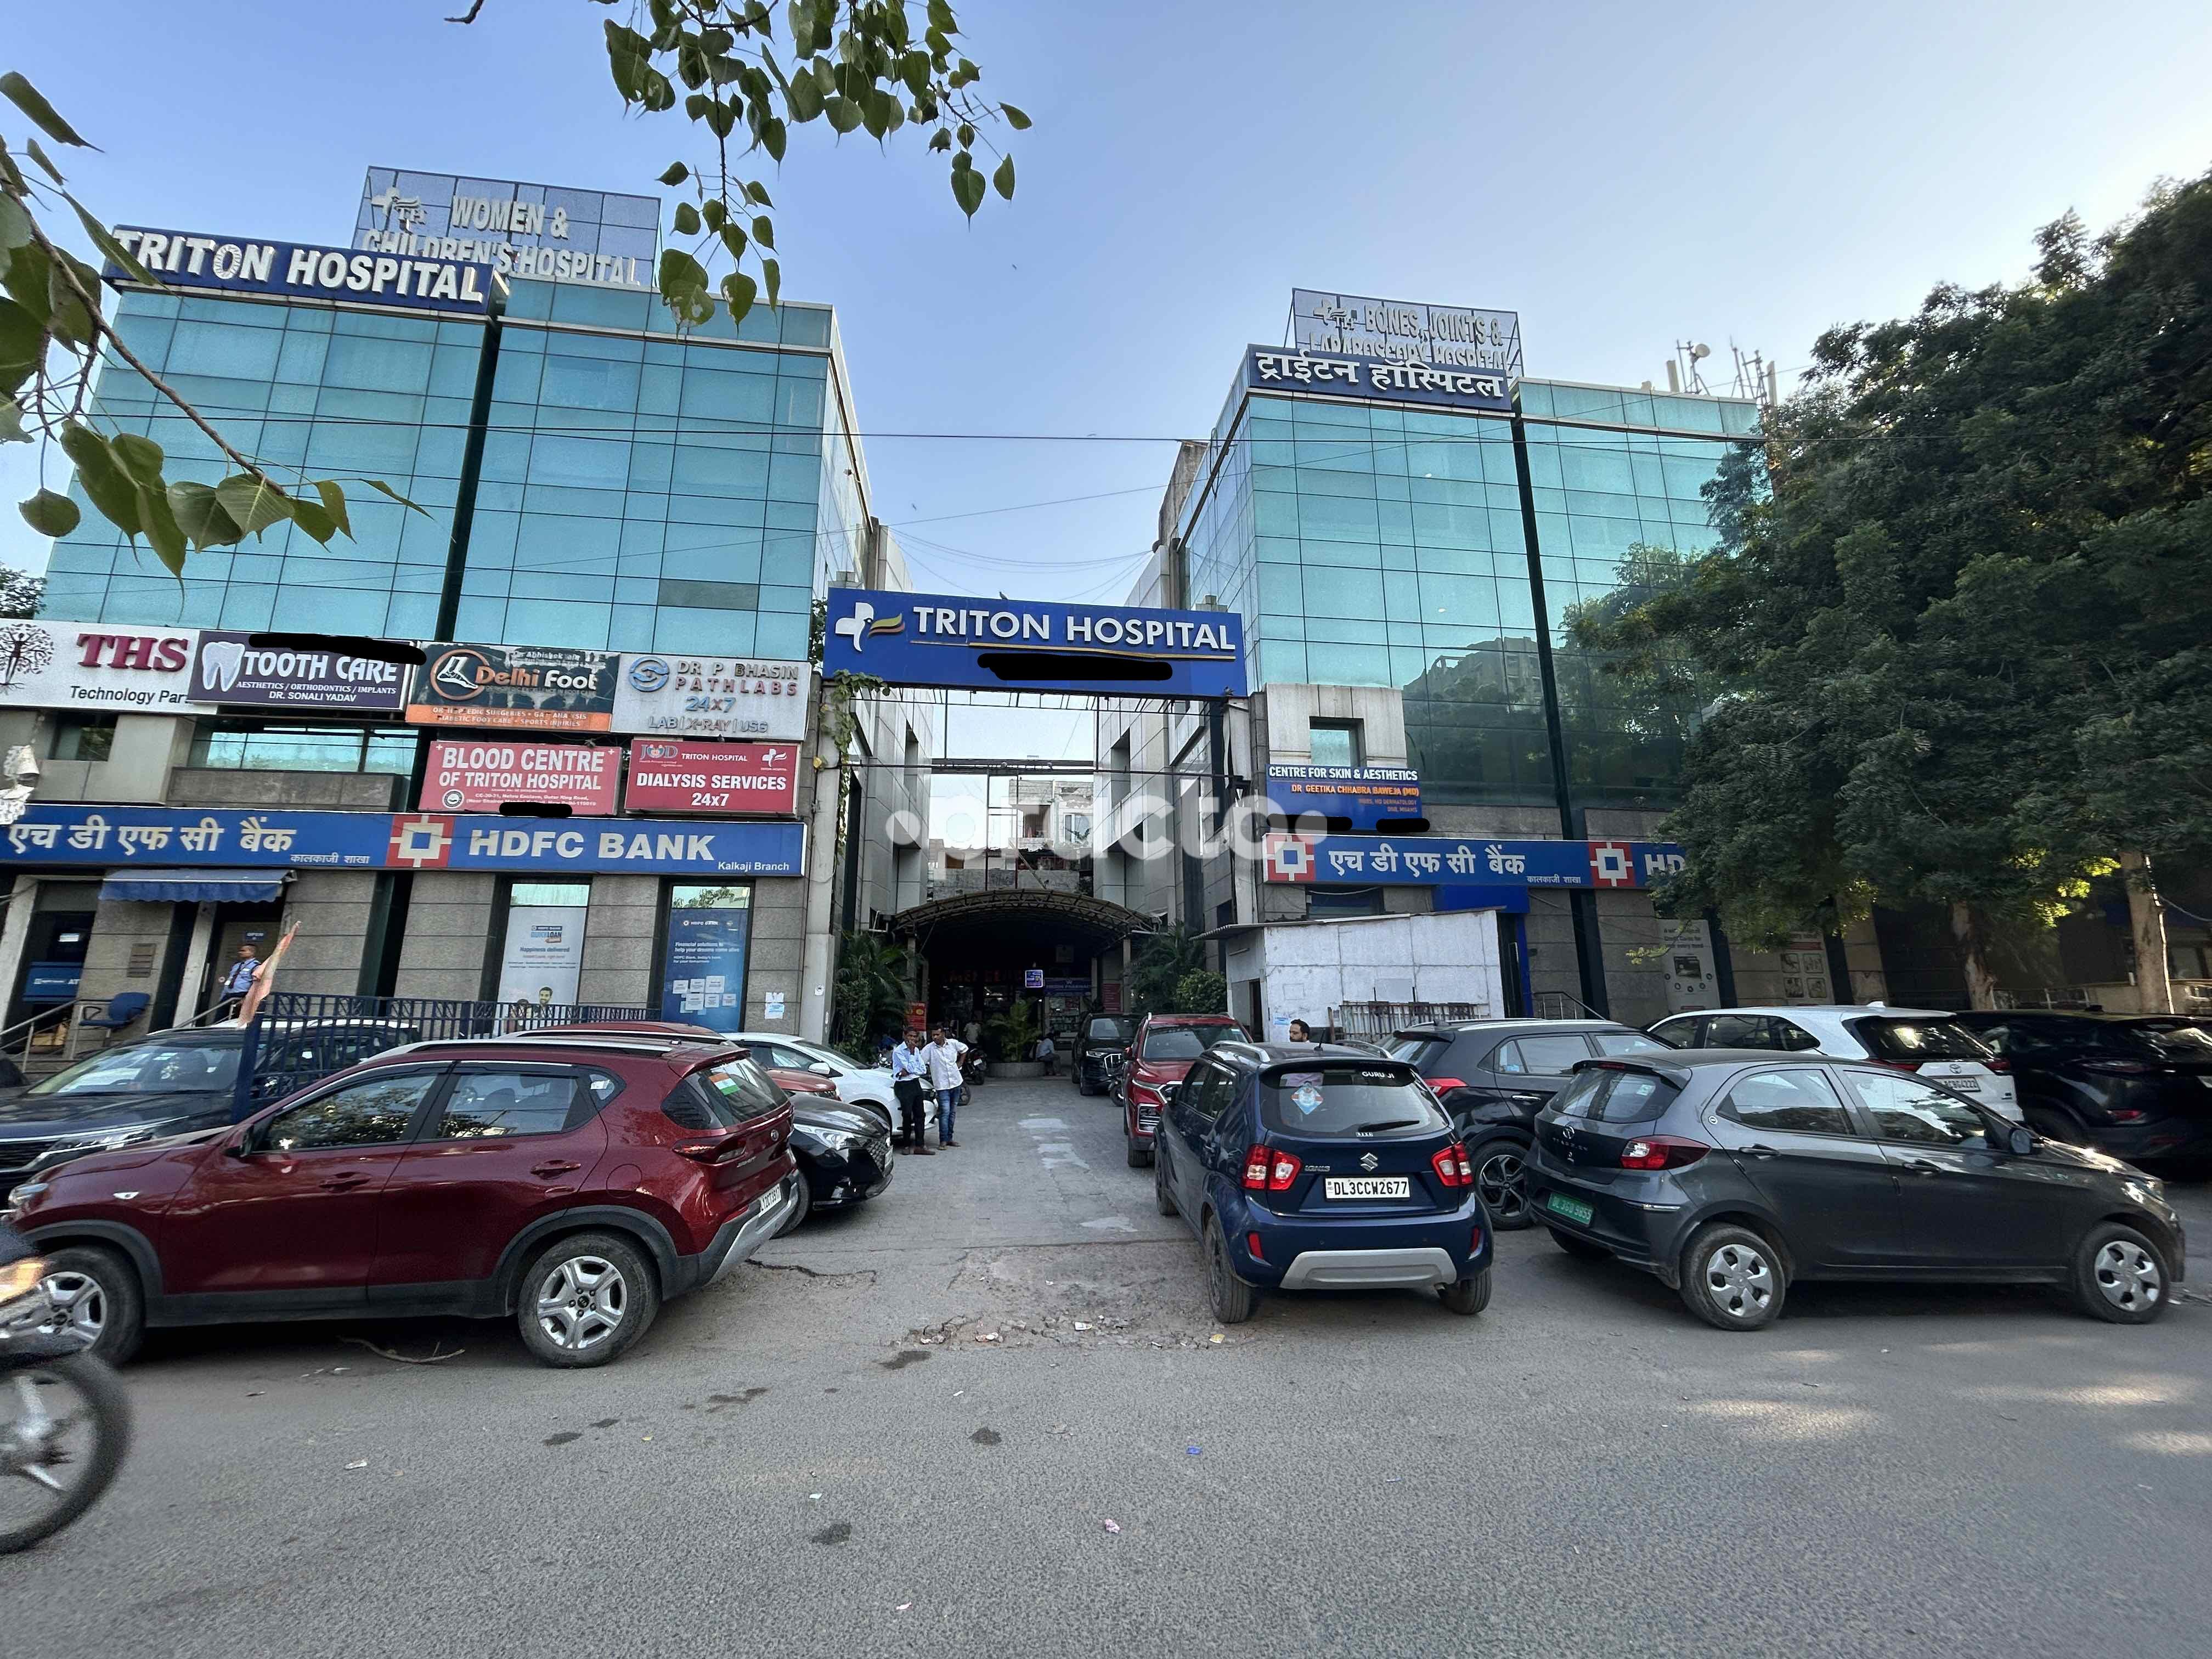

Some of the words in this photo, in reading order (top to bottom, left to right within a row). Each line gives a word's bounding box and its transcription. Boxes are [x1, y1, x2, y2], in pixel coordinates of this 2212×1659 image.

[452, 195, 544, 234] WOMEN
[550, 208, 568, 240] &
[111, 229, 275, 281] TRITON
[287, 249, 486, 303] HOSPITAL
[520, 250, 639, 284] HOSPITAL
[1429, 311, 1487, 345] JOINTS
[1491, 318, 1504, 346] &
[1256, 348, 1360, 383] ट्राईटन
[1369, 359, 1504, 398] हॉस्पिटल
[913, 606, 1050, 640] TRITON
[1067, 615, 1236, 651] HOSPITAL
[77, 633, 189, 672] THS
[244, 651, 329, 681] TOOTH
[336, 656, 398, 684] CARE
[677, 660, 702, 675] DR
[713, 663, 724, 676] P
[734, 663, 799, 680] BHASIN
[236, 681, 284, 690] AESTHETICS
[291, 683, 352, 693] ORTHODONTICS
[358, 686, 397, 695] IMPLANTS
[476, 666, 540, 687] Delhi
[544, 669, 597, 690] Foot
[675, 676, 799, 696] PATHLABS
[71, 686, 155, 704] Technology
[159, 690, 191, 704] Par
[269, 691, 285, 699] DR.
[288, 692, 323, 701] SONALI
[325, 693, 357, 703] YADAV
[442, 747, 515, 770] BLOOD
[521, 748, 605, 772] CENTRE
[681, 753, 709, 761] TRITON
[712, 754, 748, 762] HOSPITAL
[439, 771, 460, 787] OF
[465, 772, 522, 788] TRITON
[526, 774, 601, 790] HOSPITAL
[636, 772, 706, 789] DIALYSIS
[710, 775, 786, 791] SERVICES
[1269, 766, 1307, 778] CENTRE
[1308, 767, 1327, 778] FOR
[1329, 769, 1351, 779] SKIN
[1353, 769, 1361, 780] &
[1363, 770, 1418, 781] AESTHETICS
[691, 793, 729, 806] 24x7
[1291, 784, 1302, 792] DR
[1305, 785, 1336, 793] GEETIKA
[1337, 786, 1372, 795] CHHABRA
[1372, 786, 1402, 796] BAWEJA
[8, 823, 61, 855] एच
[66, 815, 110, 850] डी
[118, 825, 172, 856] एफ
[179, 817, 224, 852] सी
[240, 816, 296, 853] बैंक
[469, 830, 584, 859] HDFC
[597, 832, 715, 861] BANK
[290, 853, 338, 865] कालकाजी
[344, 854, 370, 865] शाखा
[718, 861, 751, 872] Kalkaji
[754, 862, 790, 872] Branch
[1328, 850, 1364, 877] एच
[1369, 844, 1399, 872] डी
[1403, 851, 1441, 877] एफ
[1445, 846, 1476, 874] सी
[1484, 845, 1526, 874] बैंक
[1334, 1181, 1408, 1195] DL3CCW2677
